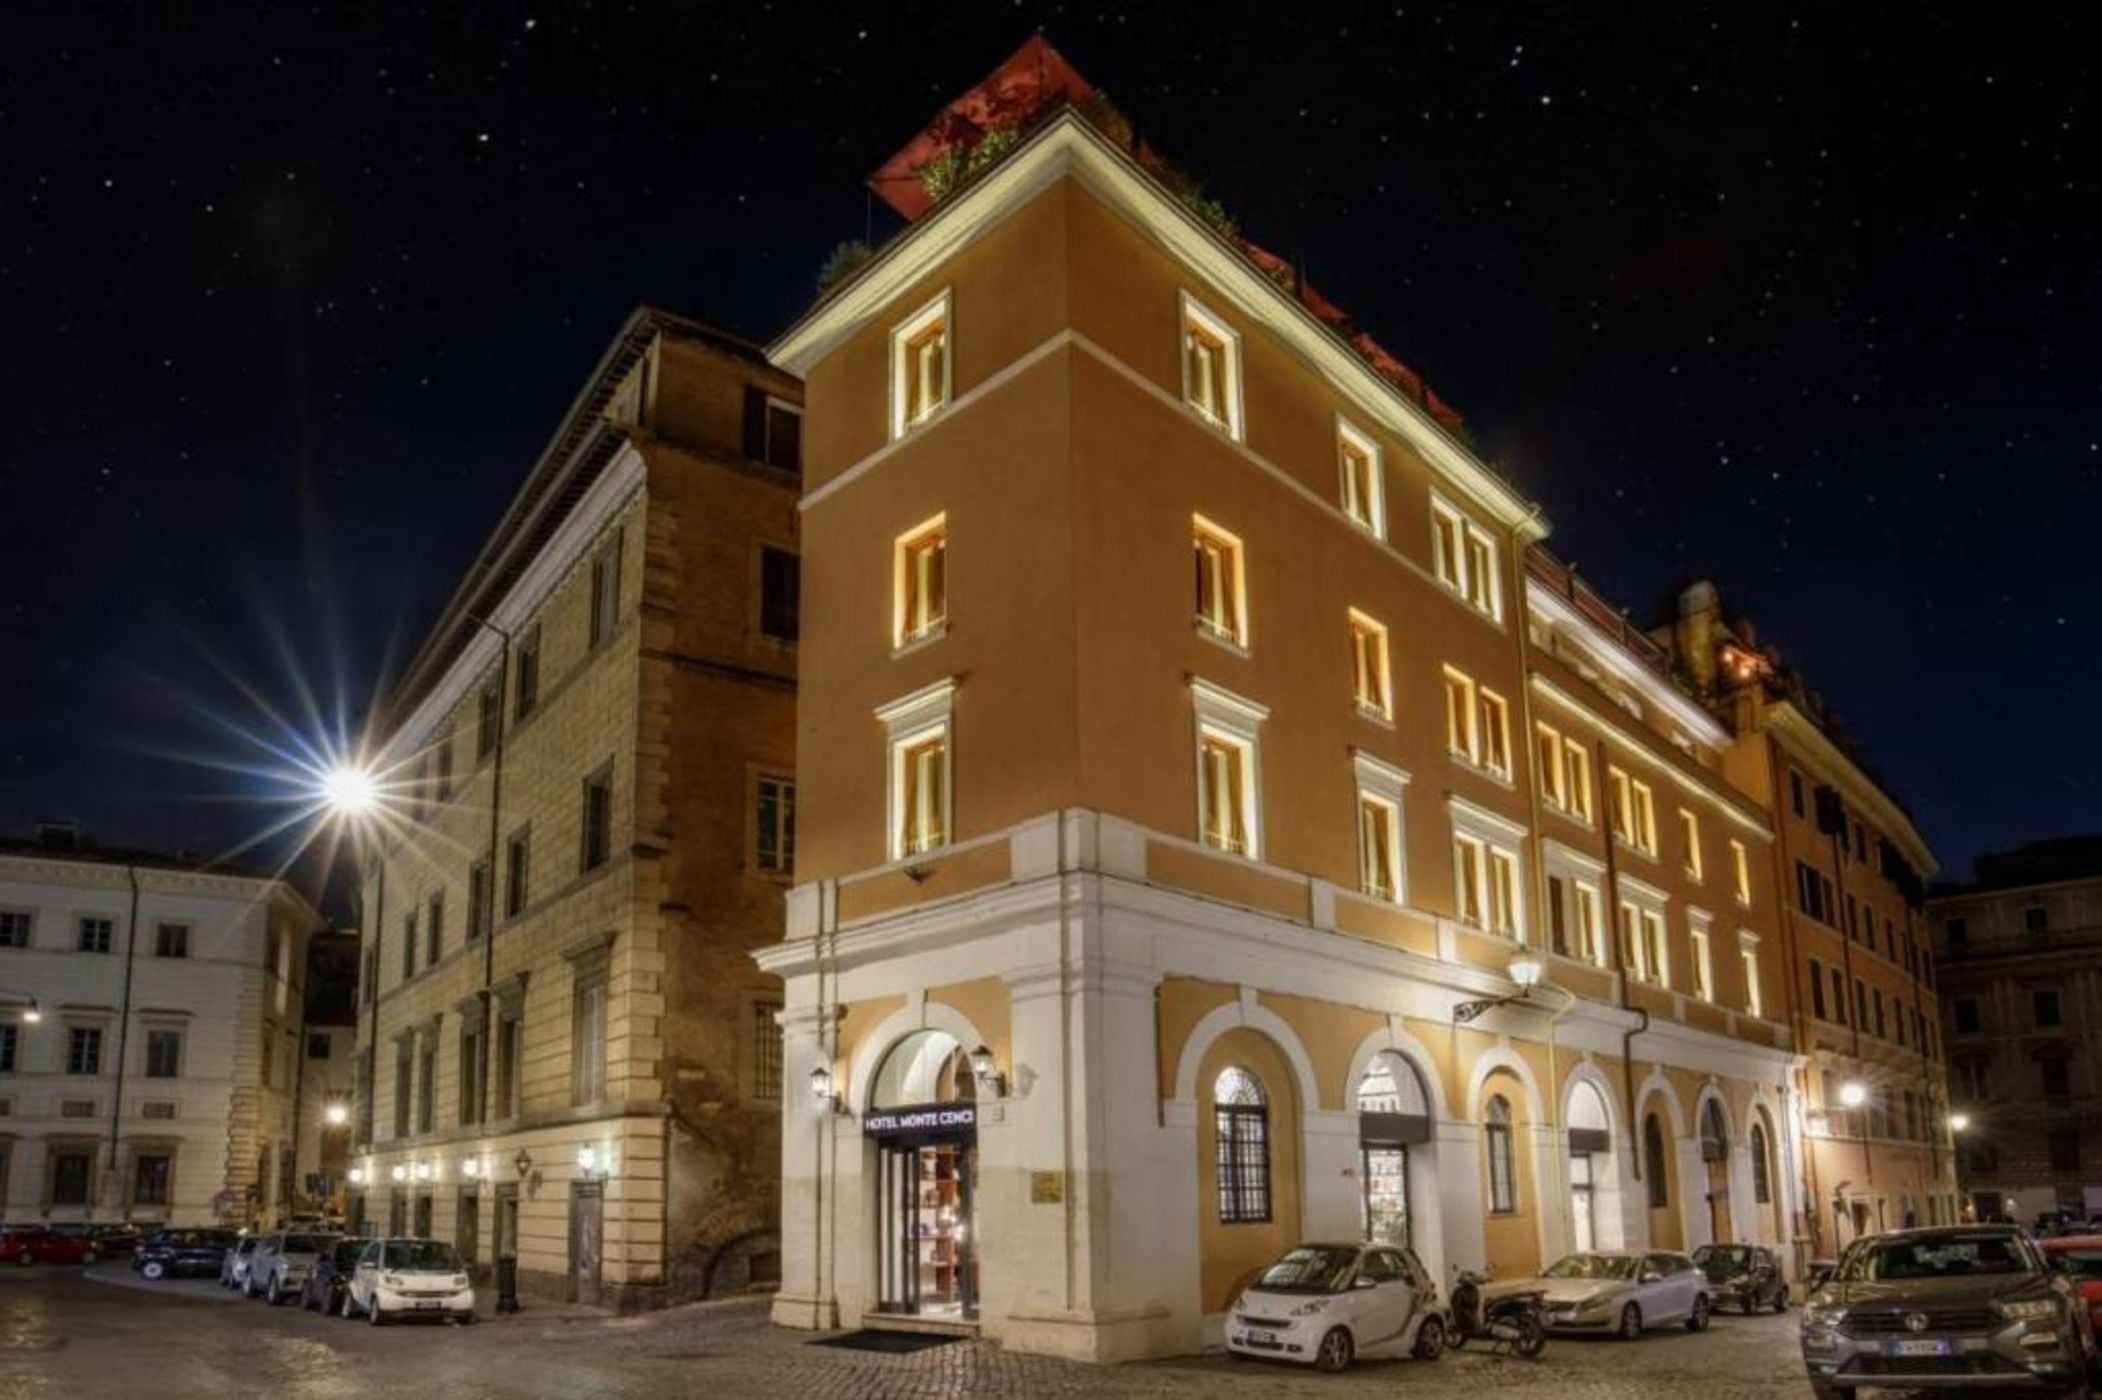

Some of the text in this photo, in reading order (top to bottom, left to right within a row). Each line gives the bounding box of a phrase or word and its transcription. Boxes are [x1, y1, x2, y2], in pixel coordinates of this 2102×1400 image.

[866, 1110, 974, 1130] HOTEL MONTE CENCI
